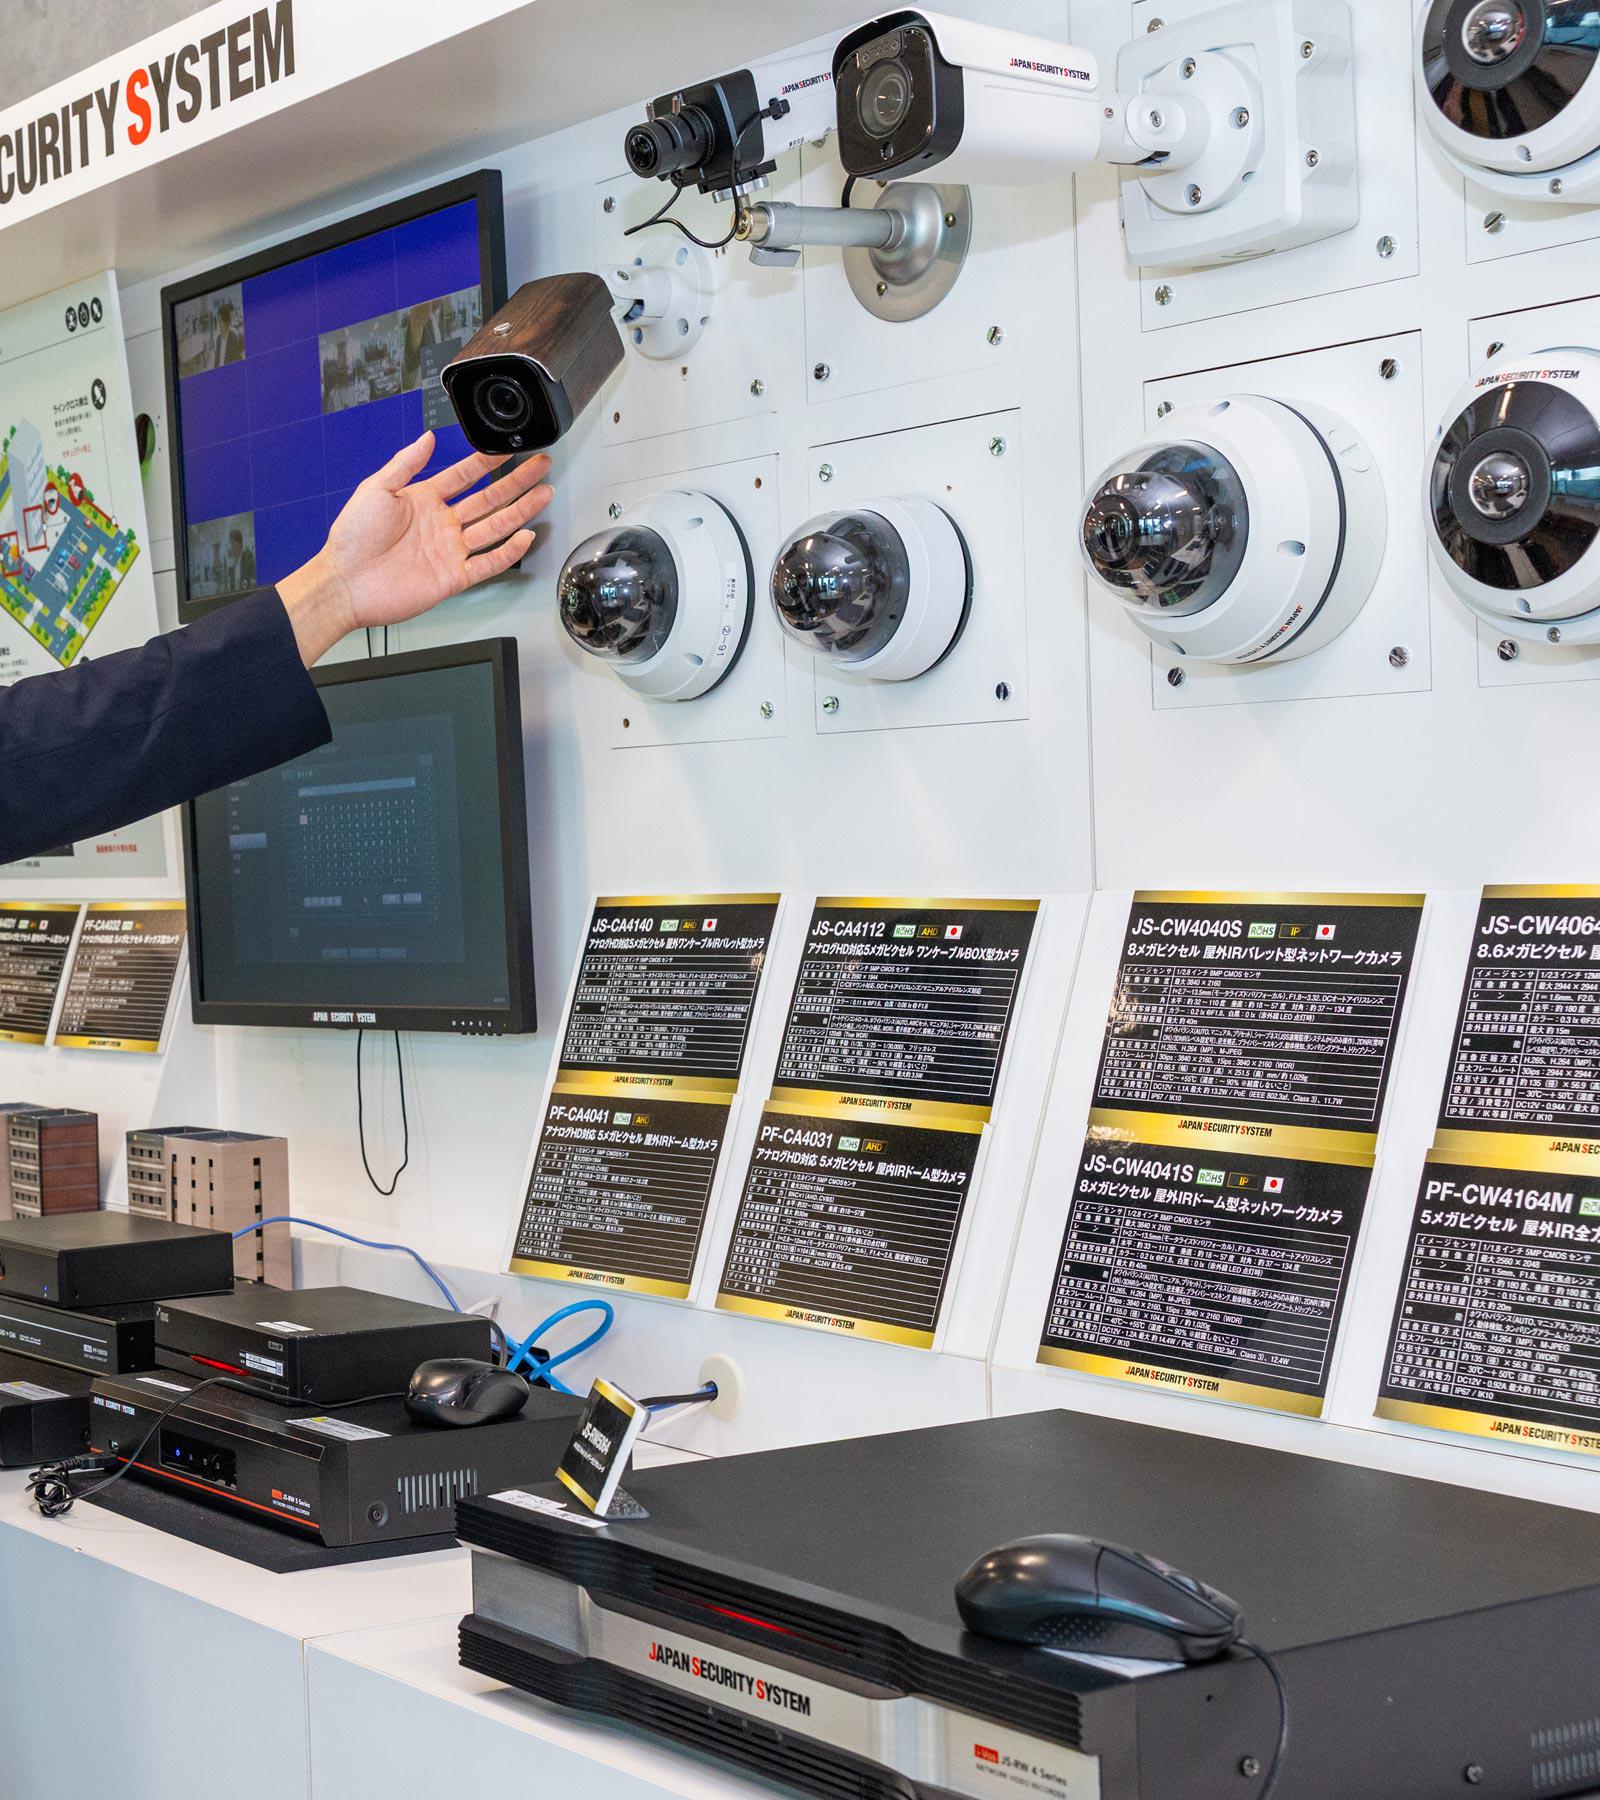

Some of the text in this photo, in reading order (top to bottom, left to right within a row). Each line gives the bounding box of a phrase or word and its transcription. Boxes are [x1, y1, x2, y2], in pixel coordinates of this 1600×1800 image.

[126, 0, 296, 146] SYSTEM
[1009, 57, 1090, 82] JAPAN SECURITY SYSTEM
[781, 83, 799, 96] JAPAN
[799, 76, 825, 90] SECURITY
[1474, 369, 1580, 388] JAPAN SECURITY SYSTEM
[1284, 604, 1303, 626] JAPAN
[591, 918, 654, 932] JS-CA4140
[811, 920, 886, 937] JS-CA4112
[921, 927, 938, 935] AHD
[1130, 917, 1243, 937] JS-CW4040S
[1290, 927, 1300, 935] IP
[1127, 943, 1403, 966] 8メガピクセル 屋外IRバレット型ネットワークカメラ
[1477, 943, 1587, 960] 8.6メガピクセル
[613, 1075, 629, 1083] JAPAN
[628, 1076, 653, 1084] SECURITY
[838, 1095, 912, 1110] JAPAN SECURITY SYSTEM
[548, 1105, 609, 1123] PF-CA4041
[596, 1130, 643, 1144] 5メガピクセル
[759, 1125, 833, 1148] PF-CA4031
[865, 1142, 882, 1151] AHD
[1177, 1119, 1272, 1137] JAPAN SECURITY SYSTEM
[1549, 1141, 1580, 1153] JAPAN
[755, 1147, 967, 1185] アナログHD対応 5メガピクセル 屋内IRドーム型カメラ
[1083, 1153, 1194, 1183] JS-CW4041S
[1238, 1177, 1248, 1186] IP
[1079, 1179, 1344, 1225] 8メガピクセル 屋外IRドーム型ネットワークカメラ
[1425, 1180, 1574, 1214] PF-CW4164M
[1173, 1216, 1192, 1224] CMOS
[1420, 1210, 1518, 1232] 5メガピクセル
[1419, 1237, 1477, 1249] イメージセンサ
[1543, 1251, 1567, 1260] CMOS
[1569, 1253, 1592, 1263] センサ
[567, 1269, 625, 1285] JAPAN SECURITY SYSTEM
[784, 1308, 855, 1330] JAPAN SECURITY SYSTEM
[1125, 1365, 1219, 1391] JAPAN SECURITY SYSTEM
[1490, 1421, 1600, 1449] JAPAN SECURITY SYSTE
[649, 1642, 811, 1716] JAPAN SECURITY SYSTEM
[976, 1763, 1066, 1799] NETWORK VIDEO RECORDER
[1040, 1769, 1067, 1786] Series
